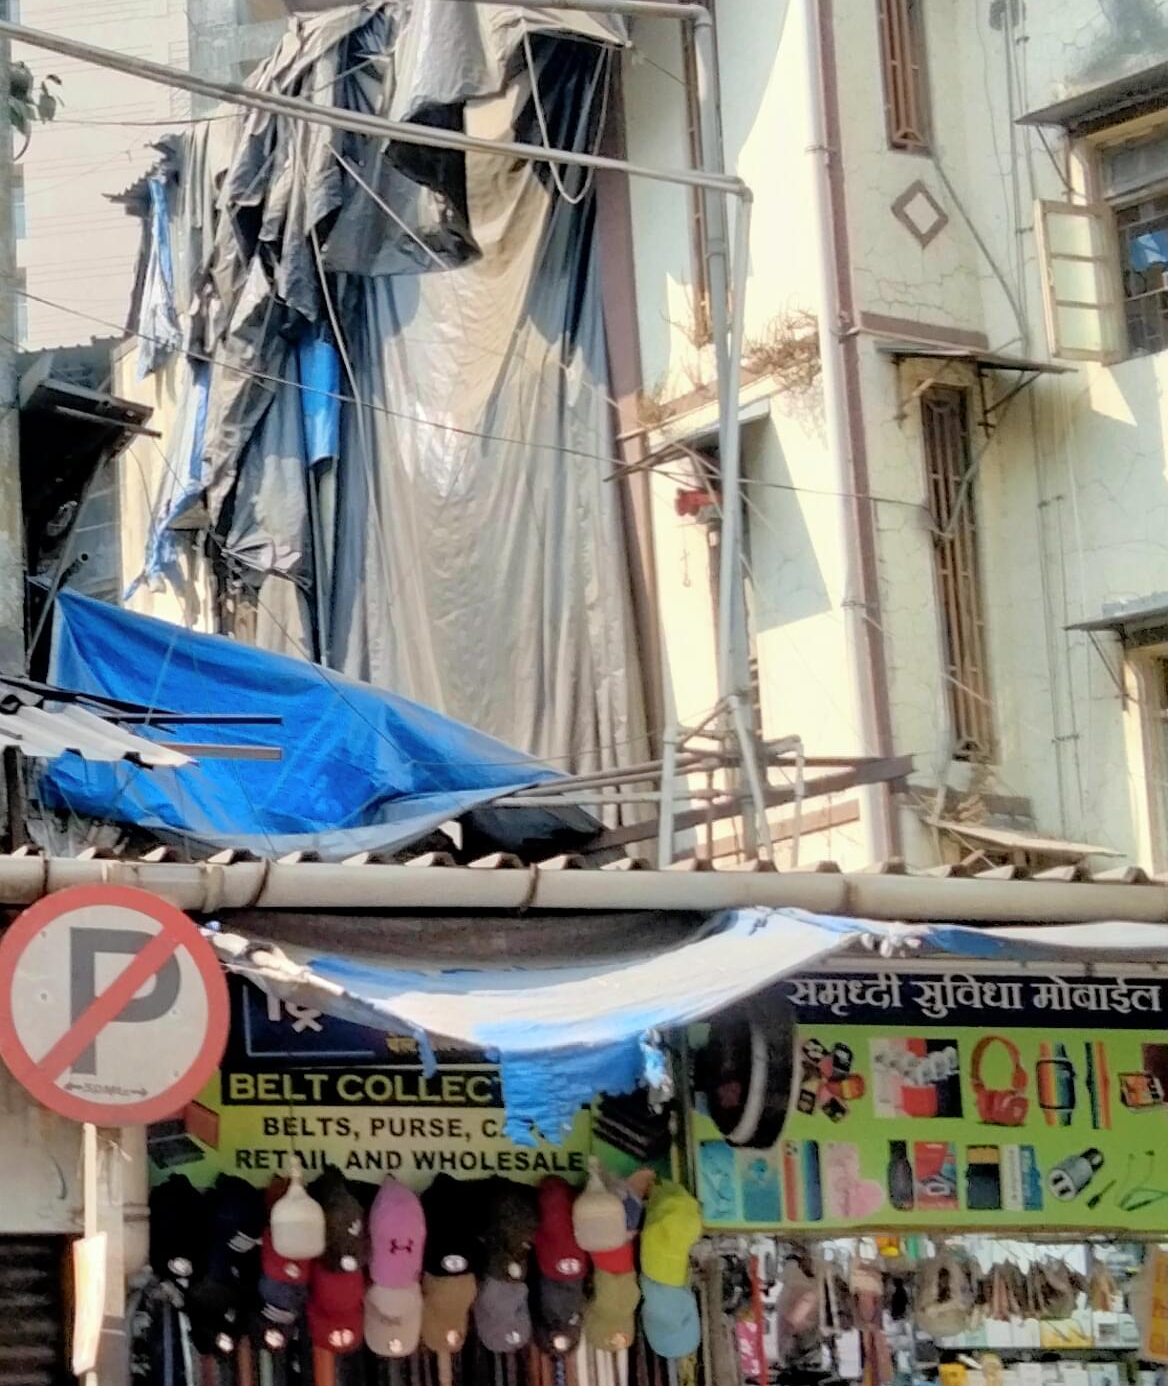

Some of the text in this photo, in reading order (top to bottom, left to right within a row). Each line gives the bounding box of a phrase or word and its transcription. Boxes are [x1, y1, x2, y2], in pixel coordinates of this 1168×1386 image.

[911, 972, 1023, 1018] सुविधा
[1032, 975, 1163, 1015] मोबाईल
[228, 1072, 505, 1102] BELT COLLEC
[262, 1116, 360, 1141] BELTS,
[370, 1117, 472, 1142] PURSE,
[345, 1151, 403, 1171] AND
[411, 1151, 584, 1173] WHOLESALE
